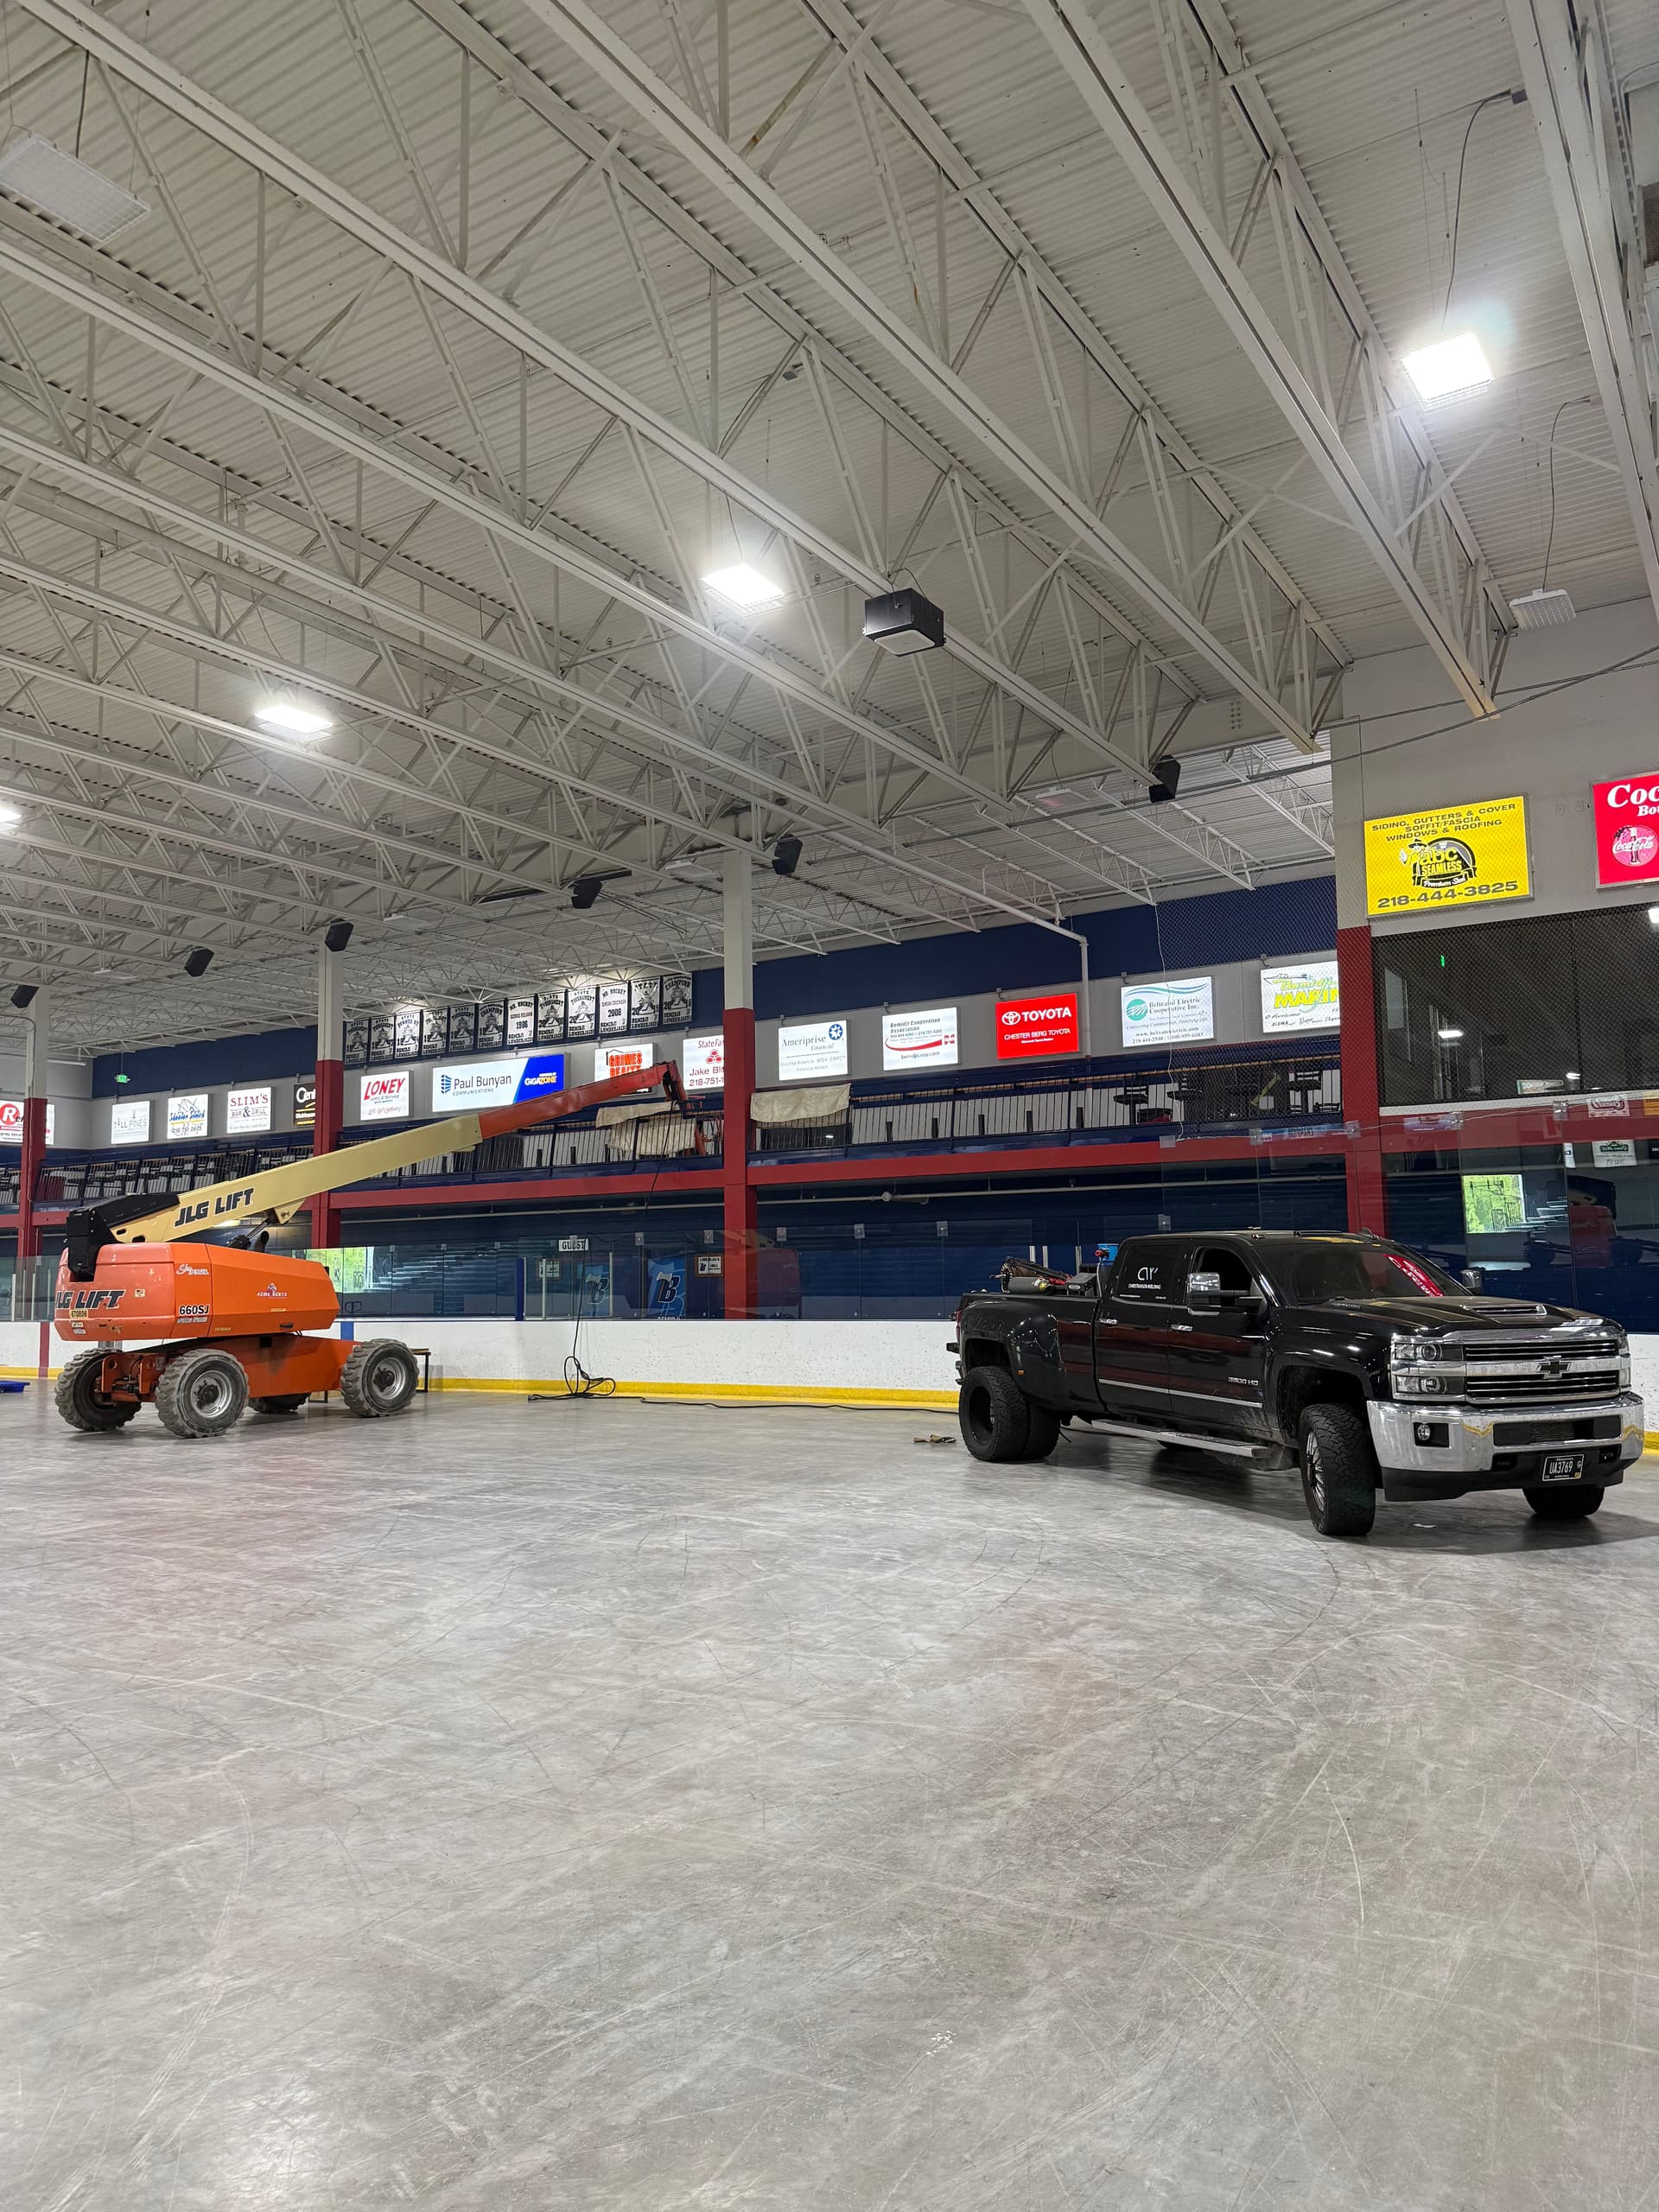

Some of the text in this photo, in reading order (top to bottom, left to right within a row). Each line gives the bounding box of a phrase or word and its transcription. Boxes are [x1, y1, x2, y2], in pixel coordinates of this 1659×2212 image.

[1372, 822, 1409, 831] SIDING,
[1414, 812, 1462, 824] GUTTERS
[1478, 804, 1516, 815] COVER
[1405, 816, 1481, 832] SOFFIT/FASCIA
[1386, 829, 1438, 842] WINDOWS
[1454, 819, 1503, 832] ROOFING
[1419, 848, 1459, 865] abc
[1421, 861, 1462, 875] SEAMLESS
[1377, 880, 1518, 908] 218-444-3825
[1021, 1007, 1071, 1022] TOYOTA
[782, 1034, 826, 1047] Ameriprise
[609, 1052, 642, 1067] GRIMES
[690, 1068, 709, 1077] Jake
[364, 1077, 406, 1100] LONEY
[454, 1075, 512, 1090] Paul Bunyan
[230, 1094, 269, 1107] SLIM'S
[243, 1106, 251, 1118] &
[175, 1188, 254, 1227] JLG LIFT
[563, 1240, 586, 1250] GUST
[75, 1290, 125, 1309] LIFT
[179, 1305, 209, 1315] 660SJ
[1549, 1460, 1573, 1474] UA3769
